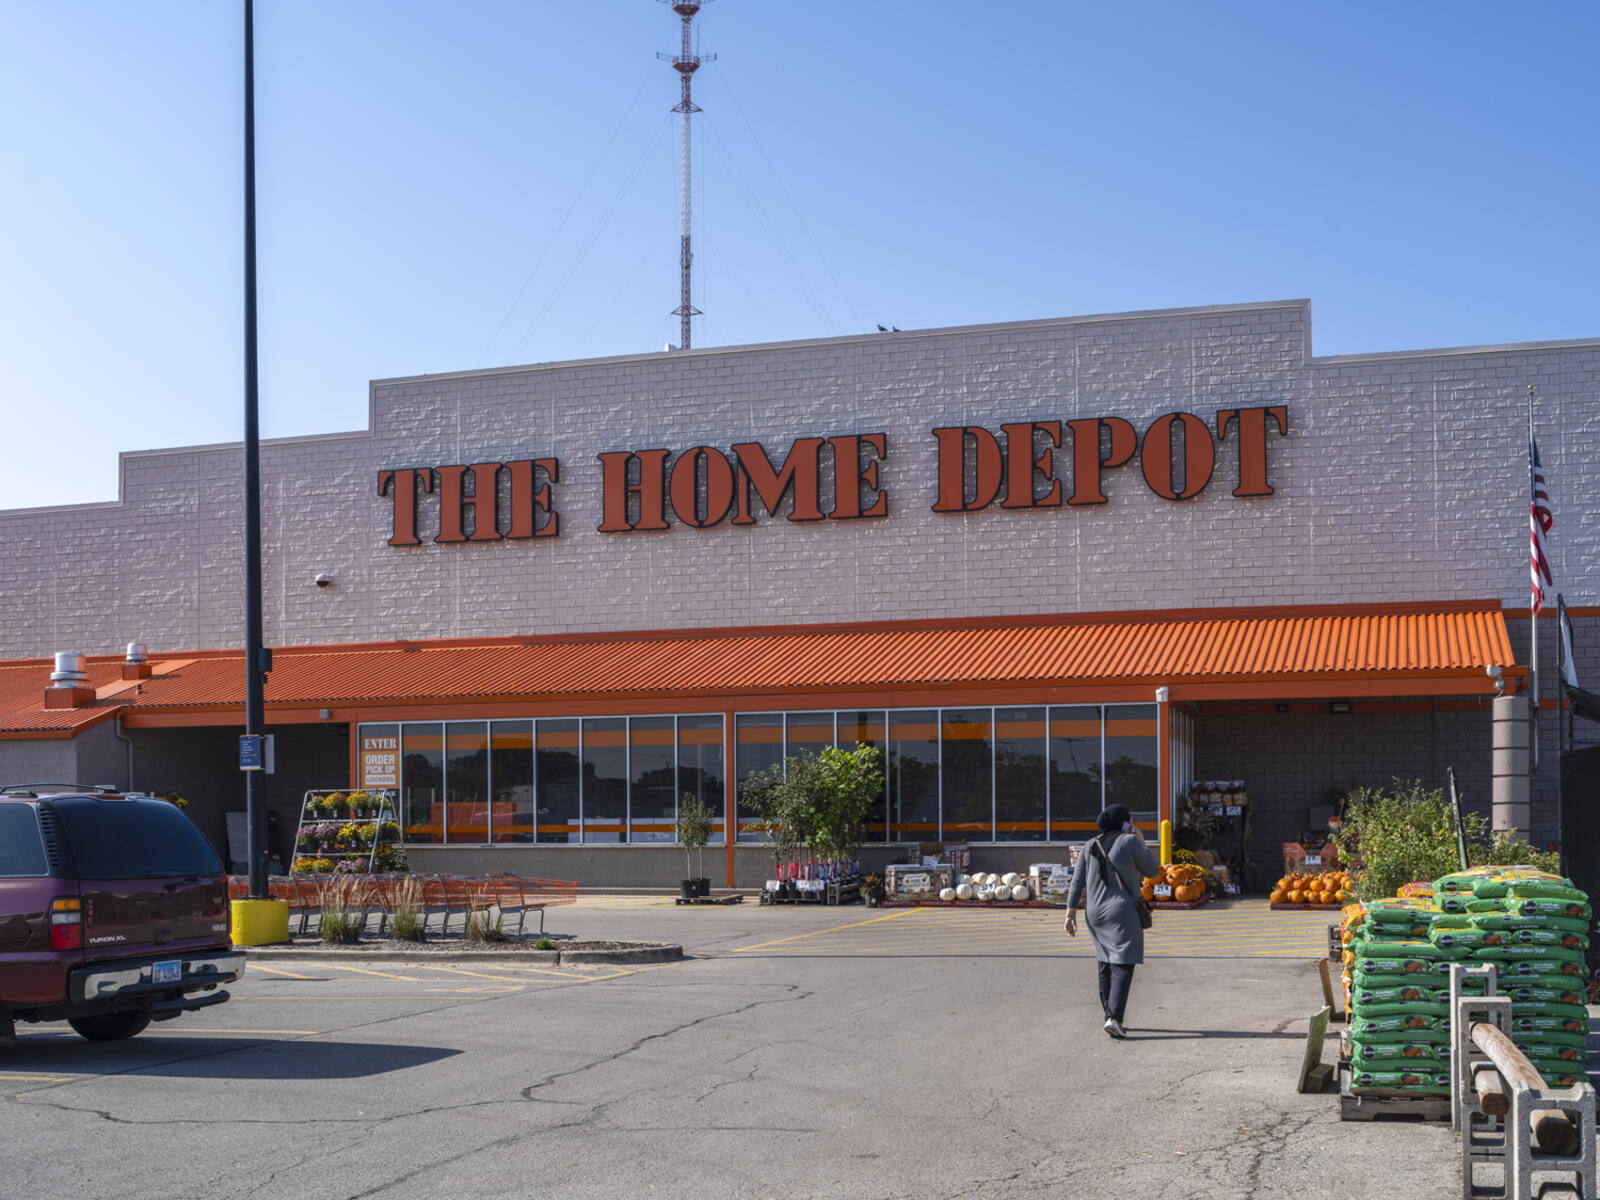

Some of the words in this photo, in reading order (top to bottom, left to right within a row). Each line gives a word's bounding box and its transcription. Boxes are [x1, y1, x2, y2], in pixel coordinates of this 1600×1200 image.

[378, 456, 560, 547] THE
[597, 432, 889, 533] HOME
[931, 404, 1289, 514] DEPOT
[365, 738, 397, 750] ENTER
[366, 754, 396, 765] ORDER
[366, 765, 384, 774] PICK
[89, 936, 115, 944] YUKON
